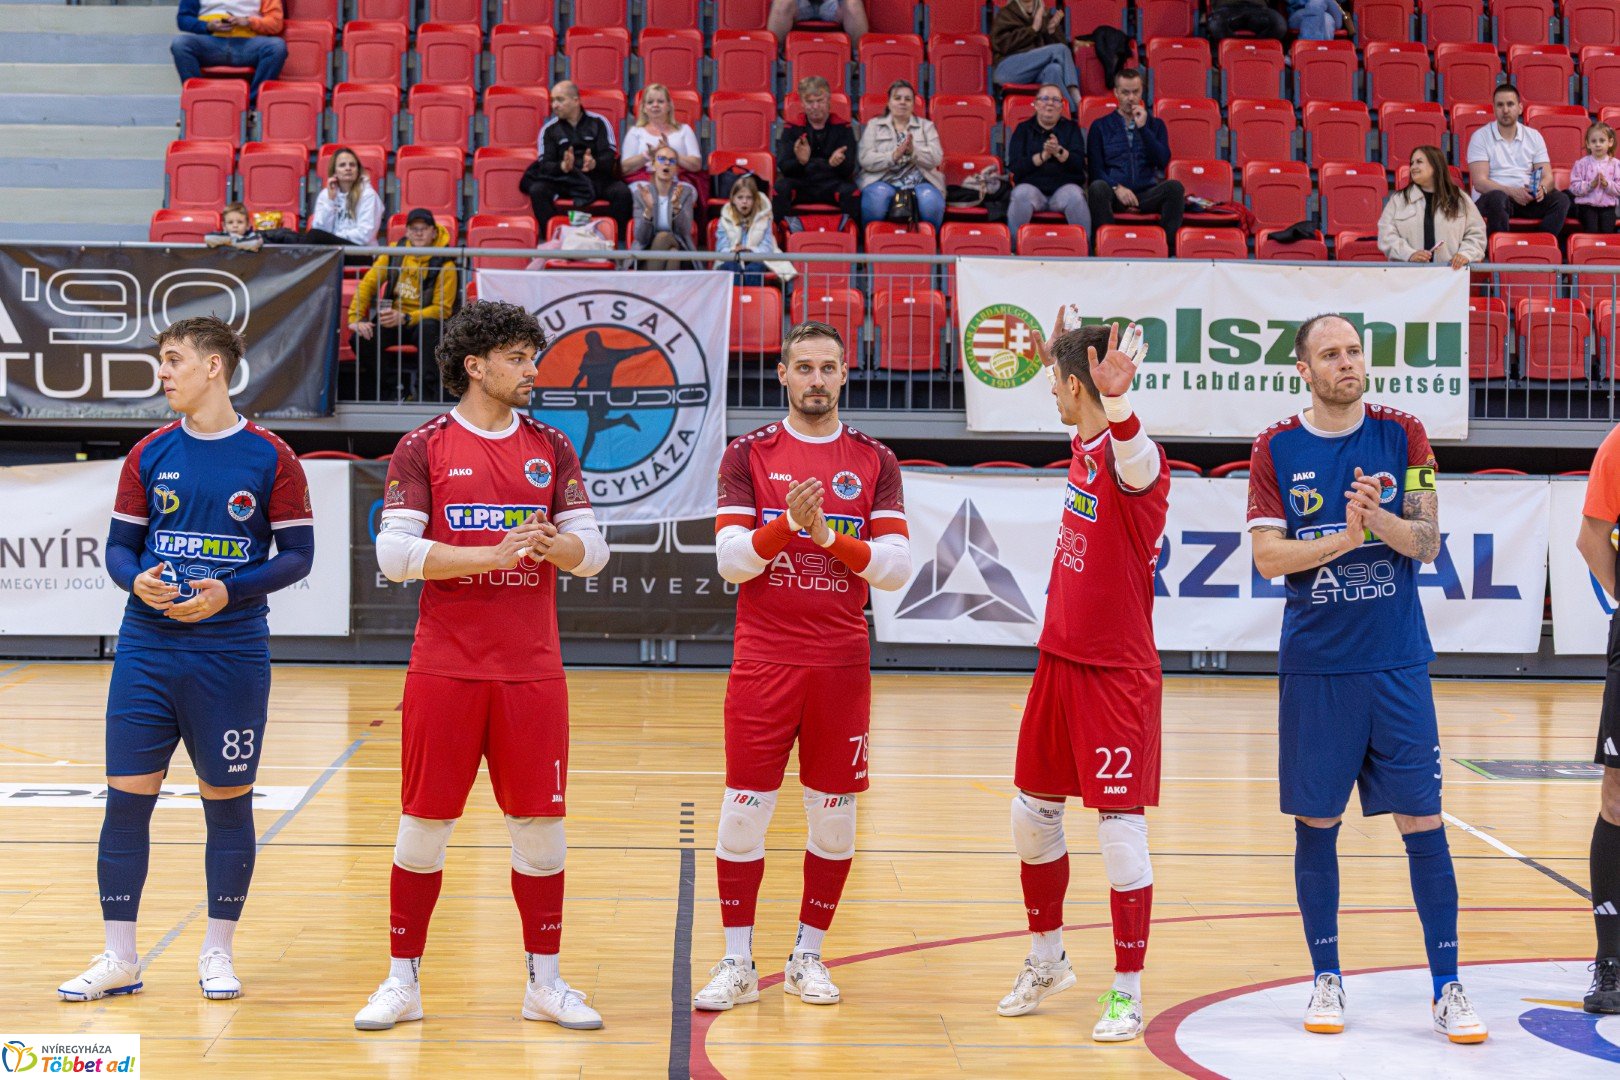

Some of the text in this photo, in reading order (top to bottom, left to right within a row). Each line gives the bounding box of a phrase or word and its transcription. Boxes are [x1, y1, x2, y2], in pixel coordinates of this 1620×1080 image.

[544, 300, 683, 354] UTSAL
[158, 472, 179, 480] JAKO
[448, 467, 473, 476] JAKO
[769, 472, 792, 482] JAKO
[1292, 471, 1316, 482] JAKO
[1418, 469, 1434, 488] C
[0, 529, 103, 568] NYÍR
[1312, 559, 1395, 590] A'90
[0, 578, 57, 590] MEGYEI
[64, 576, 105, 590] JOGÚ
[768, 573, 849, 594] STUDIO
[1312, 582, 1396, 604] STUDIO
[222, 729, 255, 761] 83
[228, 763, 248, 773] JAKO
[1095, 746, 1133, 779] 22
[554, 759, 560, 791] 1
[1103, 785, 1128, 795] JAKO
[809, 898, 835, 909] JAKO
[1115, 939, 1145, 948] JAKO
